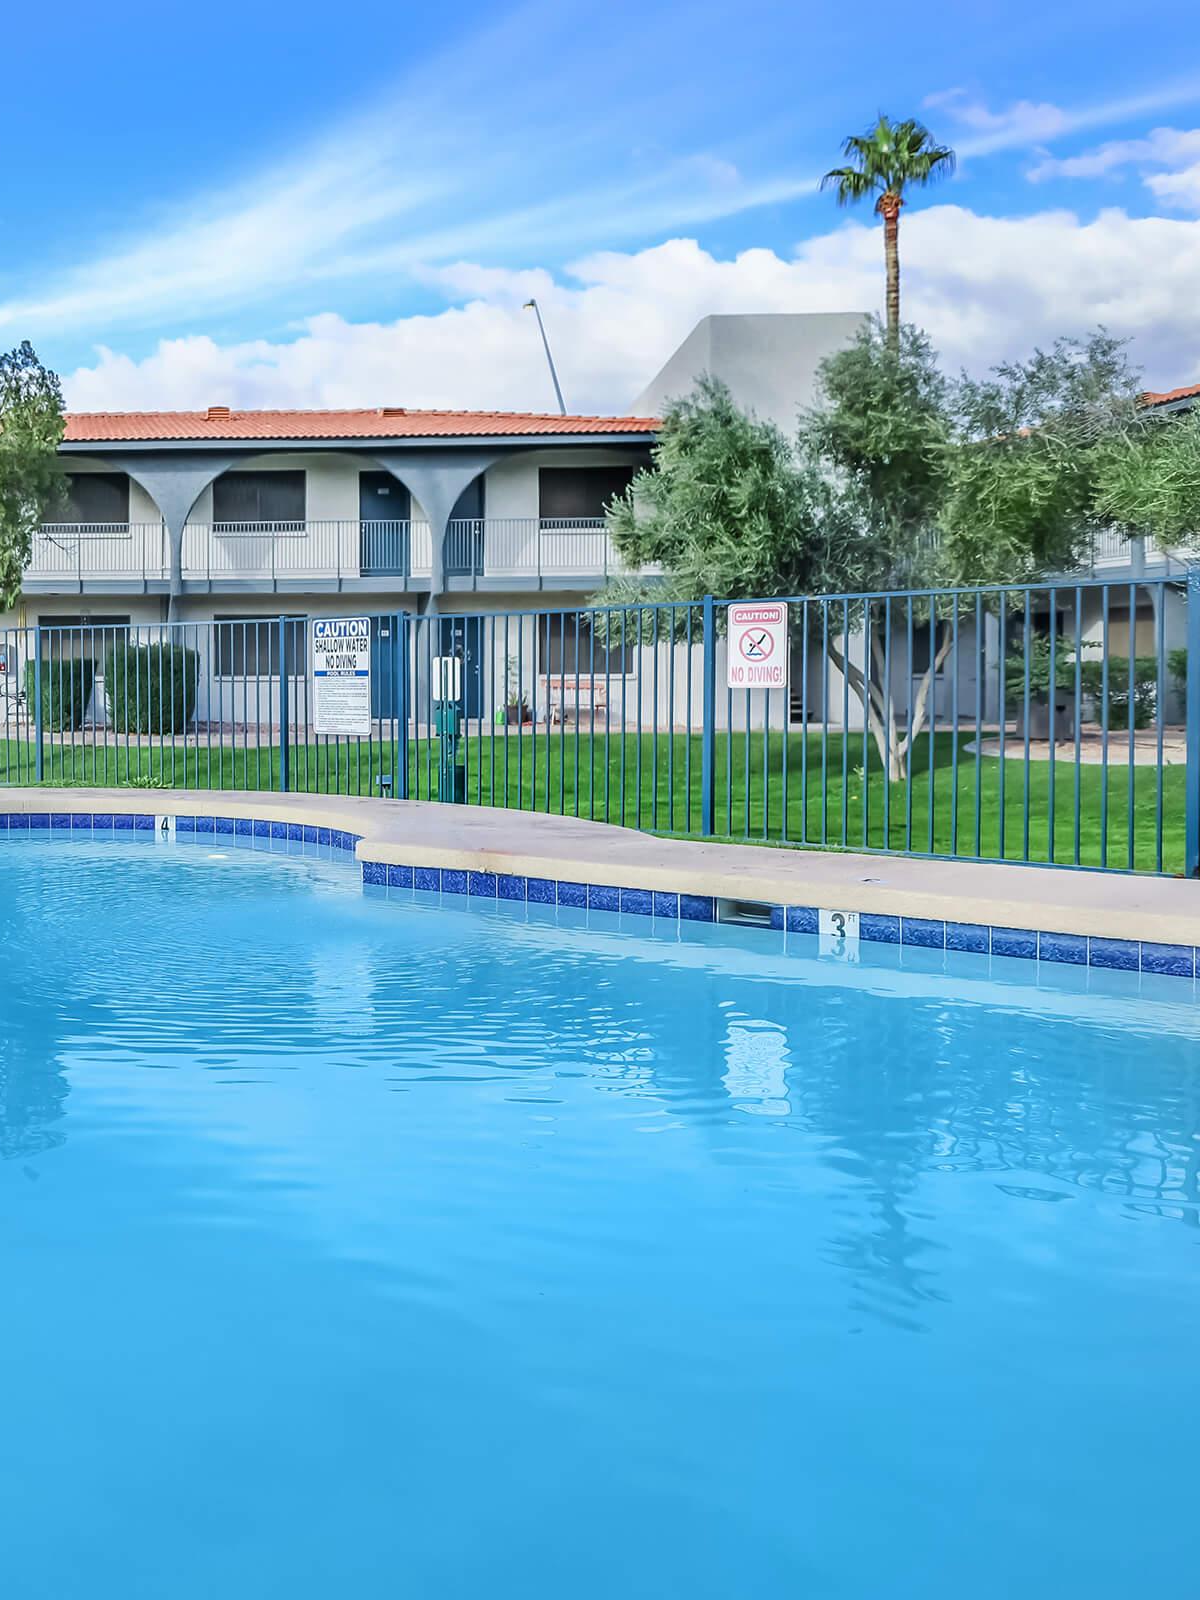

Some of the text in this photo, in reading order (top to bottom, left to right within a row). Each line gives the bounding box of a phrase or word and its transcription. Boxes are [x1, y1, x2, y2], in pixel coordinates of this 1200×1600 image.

[735, 611, 779, 621] CAUTION!
[316, 620, 367, 637] CAUTION
[315, 638, 368, 653] SHALLOW WATER
[326, 654, 357, 668] NO DIVING
[731, 666, 782, 682] NO DIVING!
[161, 816, 170, 831] 4
[831, 913, 856, 937] 3 FT
